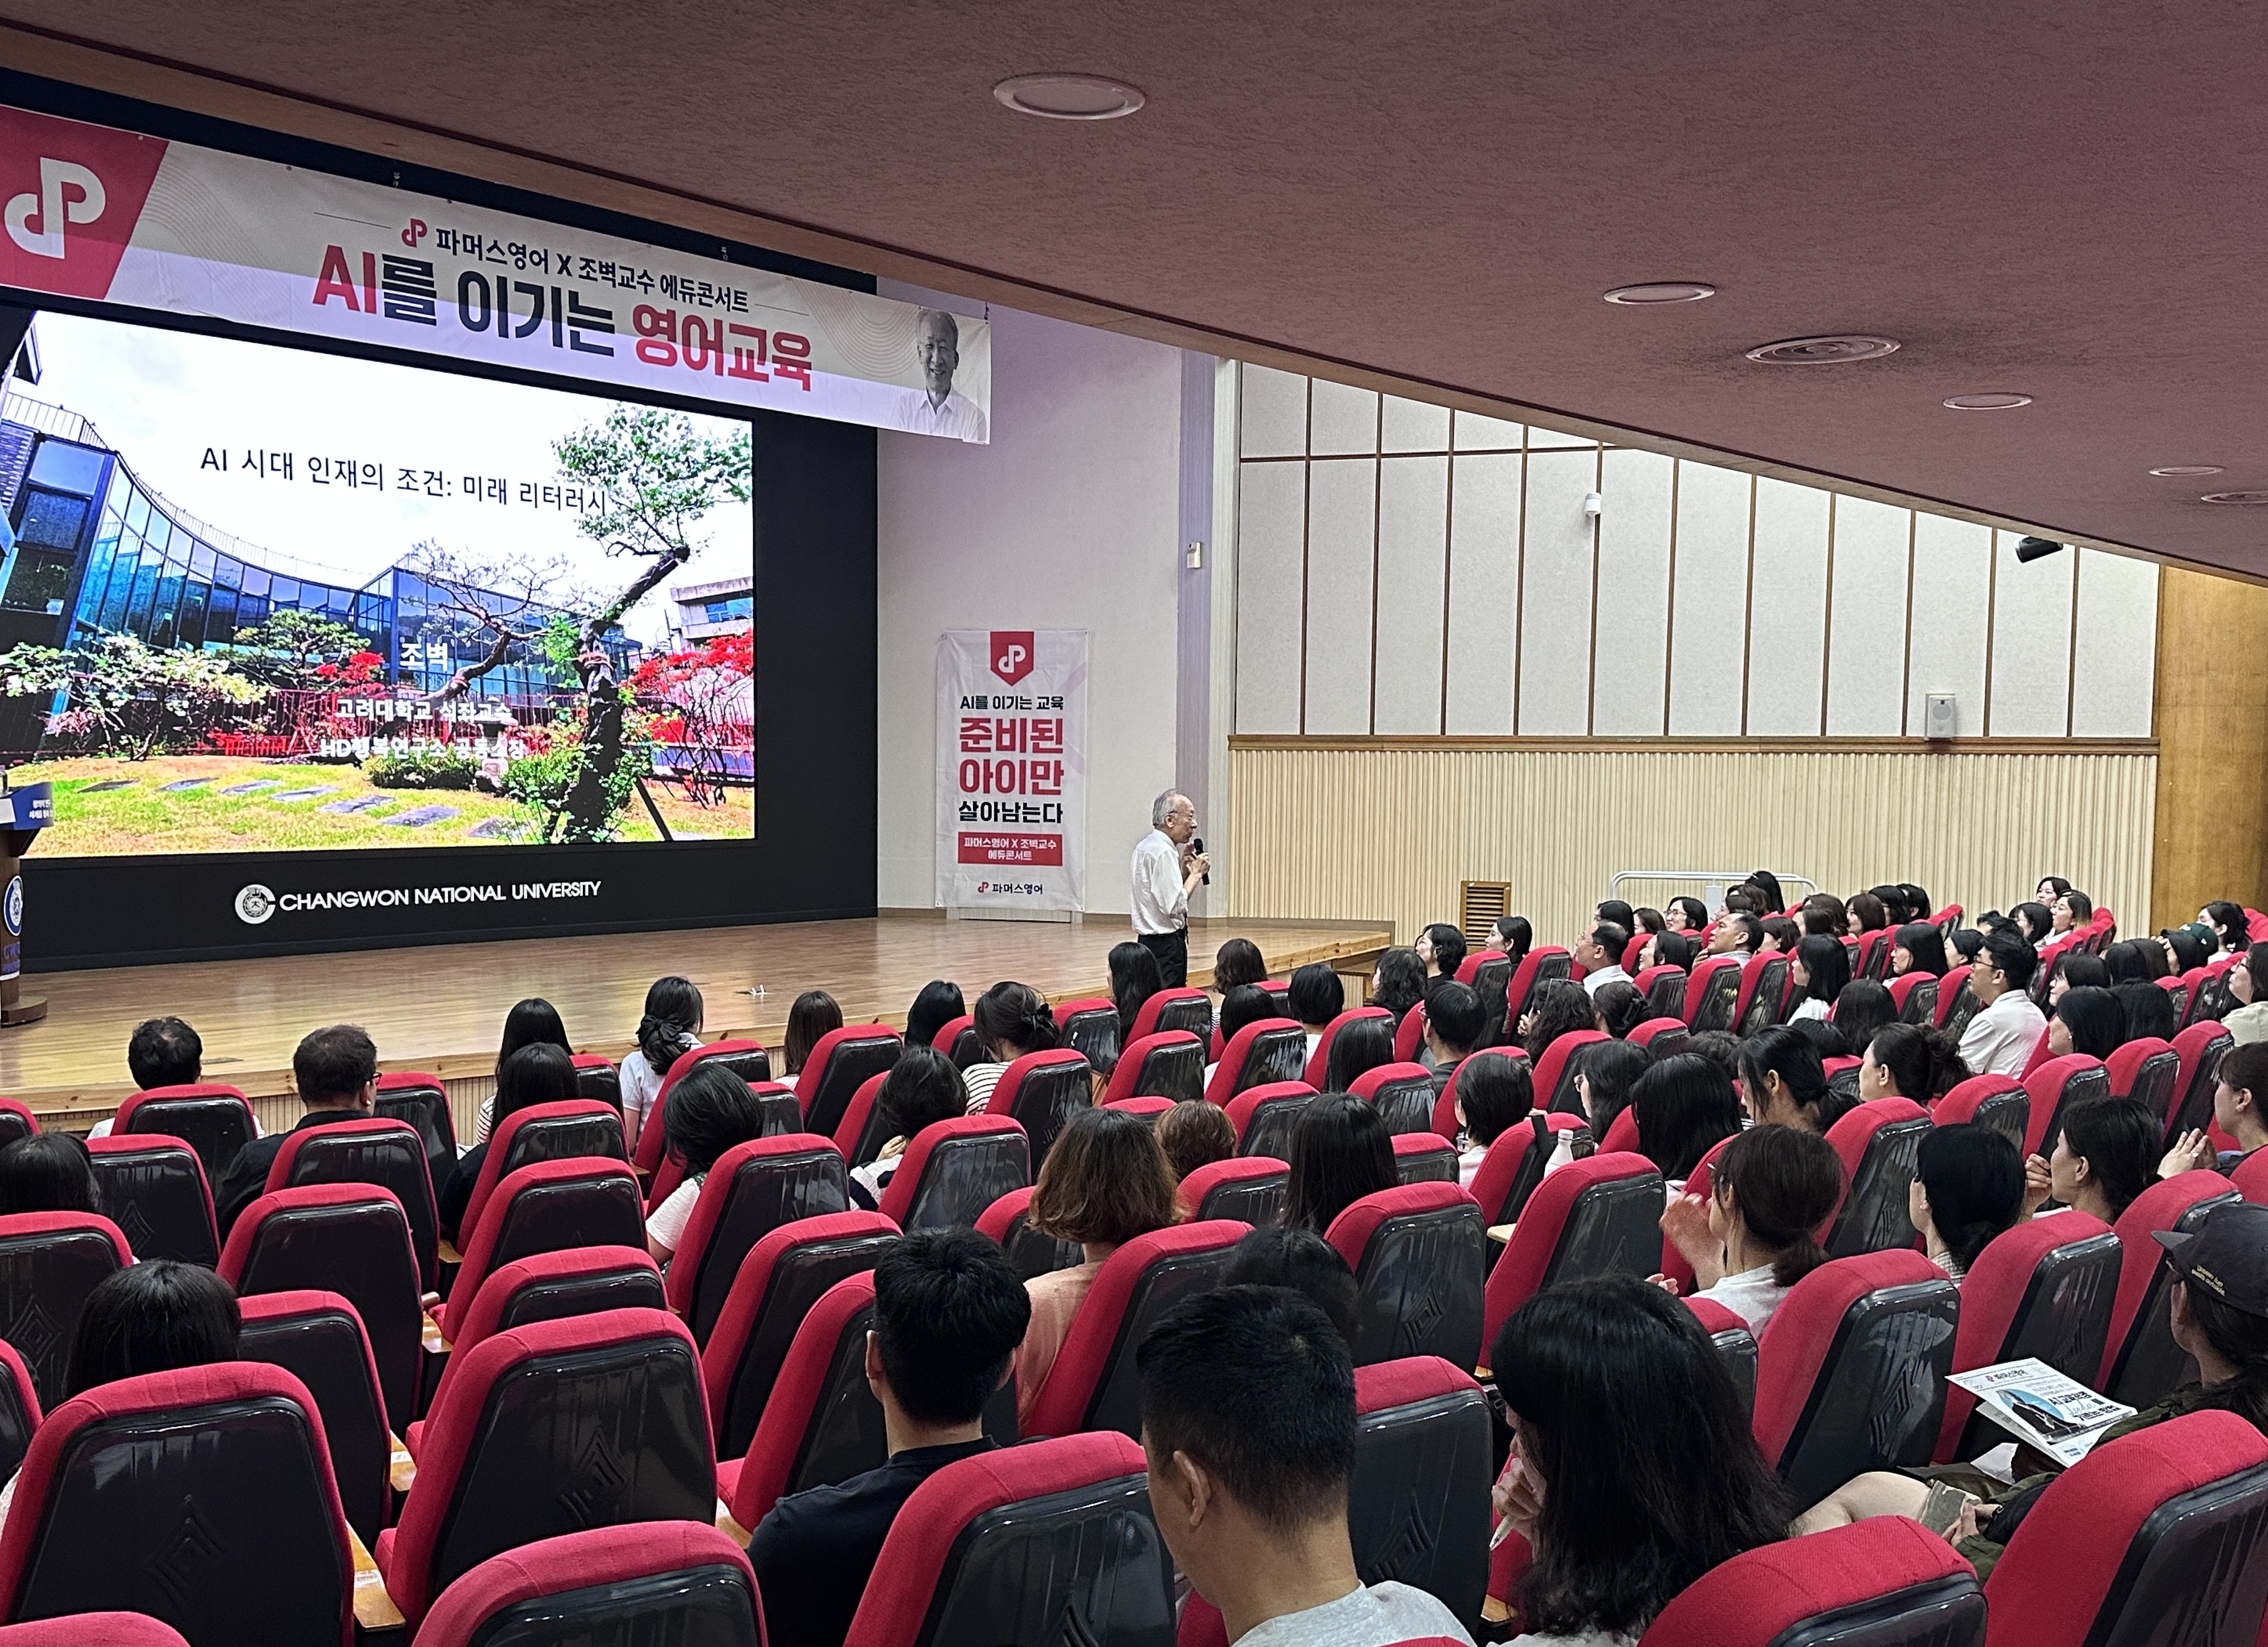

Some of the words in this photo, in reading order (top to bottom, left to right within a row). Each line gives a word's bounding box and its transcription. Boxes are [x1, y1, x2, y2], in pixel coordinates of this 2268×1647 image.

[436, 228, 549, 274] 파머스영어
[556, 253, 572, 277] X
[578, 256, 655, 295] 조벽교수
[660, 274, 749, 313] 에듀콘서트
[313, 244, 437, 327] AI를
[457, 270, 616, 357] 이기는
[632, 304, 812, 392] 영어교육
[200, 447, 228, 472] AI
[241, 449, 294, 481] 시대
[307, 456, 384, 491] 인재의
[396, 468, 452, 497] 조건:
[463, 476, 507, 506] 미래
[519, 482, 606, 516] 리터러시
[399, 642, 449, 672] 조벽
[336, 698, 433, 722] 고려대학교
[439, 701, 512, 723] 석좌교수
[960, 695, 988, 709] AI를
[992, 695, 1033, 710] 이기는
[1036, 696, 1064, 711] 교육
[453, 737, 526, 761] 공동소장
[959, 717, 1064, 754] 준비된
[959, 759, 1065, 796] 아이만
[958, 800, 1064, 824] 살아남는다
[964, 837, 1010, 848] 파머스영어
[1011, 838, 1018, 848] X
[1020, 838, 1057, 850] 조벽교수
[988, 850, 1033, 861] 에듀콘서트
[279, 888, 410, 911] CHANGWON
[414, 885, 507, 905] NATIONAL
[512, 881, 602, 901] UNIVERSITY
[992, 883, 1043, 895] 파머스영어
